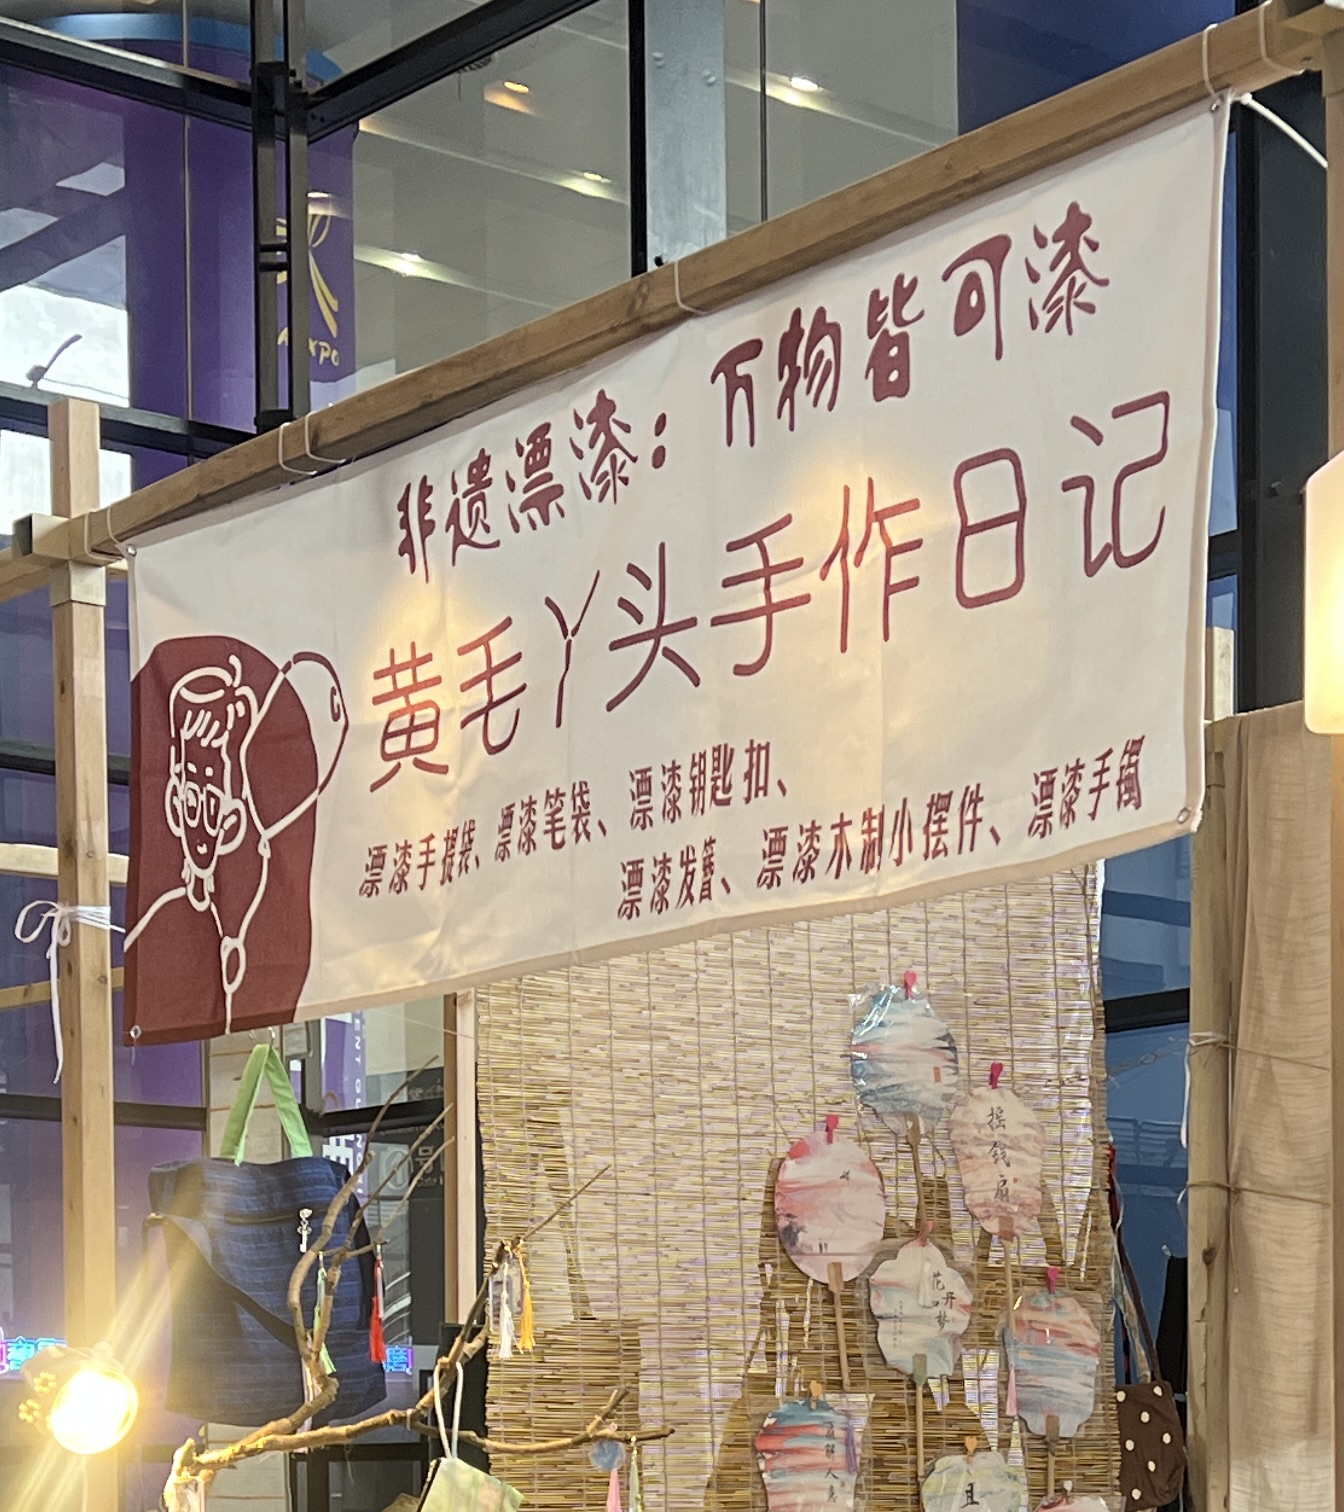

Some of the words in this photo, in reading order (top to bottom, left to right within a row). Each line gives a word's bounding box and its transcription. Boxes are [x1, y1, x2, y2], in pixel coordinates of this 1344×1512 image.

[369, 391, 1173, 792] 黄毛丫头手作日记
